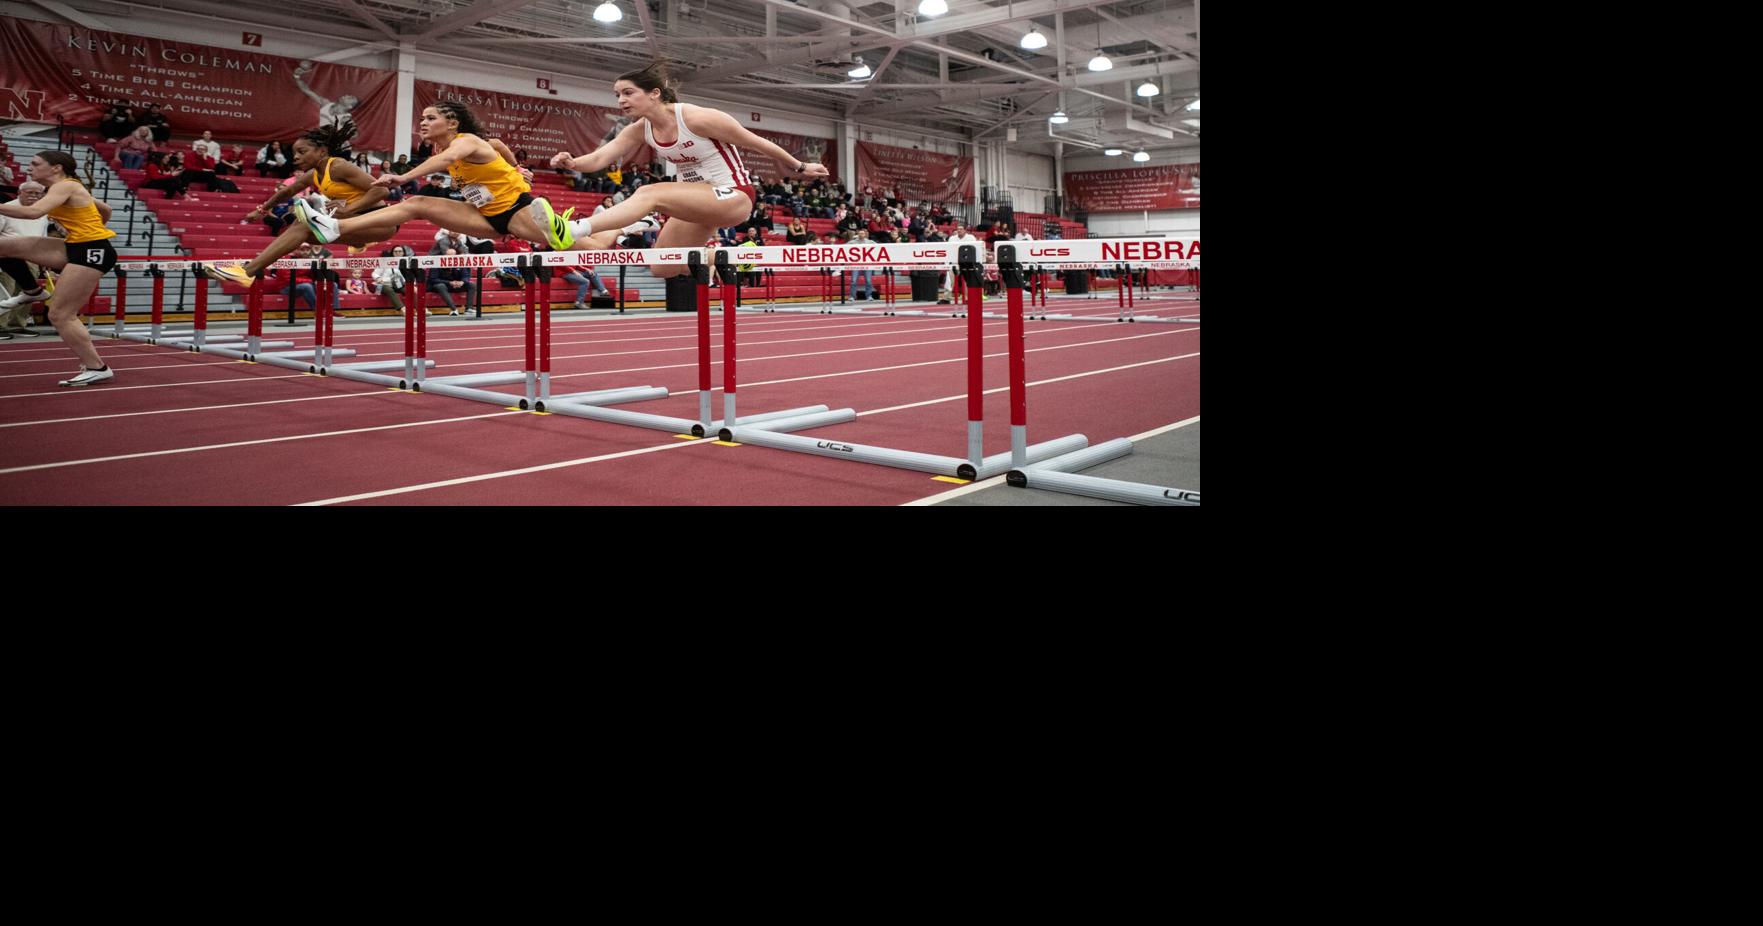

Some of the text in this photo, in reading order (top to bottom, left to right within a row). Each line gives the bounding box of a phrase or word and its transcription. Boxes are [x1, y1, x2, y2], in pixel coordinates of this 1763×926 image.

[247, 34, 257, 46] 7
[67, 35, 272, 74] KEVIN COLEMAN
[89, 70, 125, 82] TIME
[132, 76, 158, 86] BIG
[164, 79, 175, 88] 8
[181, 82, 253, 97] CHAMPION
[539, 79, 546, 88] 8
[80, 82, 243, 107] 4 TIME ALL-AMERICAN
[67, 93, 78, 101] 2
[128, 99, 173, 112] NCA
[181, 105, 252, 119] CHAMPION
[434, 89, 583, 119] TRESSA THOMPSON
[519, 125, 564, 136] CHAMPION
[522, 134, 567, 145] CHAMPION
[88, 249, 101, 265] 5
[547, 250, 683, 265] UCS NEBRASKA UCS
[737, 246, 948, 264] UCS NEBRASKA UCS
[1029, 247, 1071, 257] UCS
[345, 258, 380, 269] NEBRASKA
[440, 255, 493, 268] NEBRASKA
[816, 441, 855, 453] UCS
